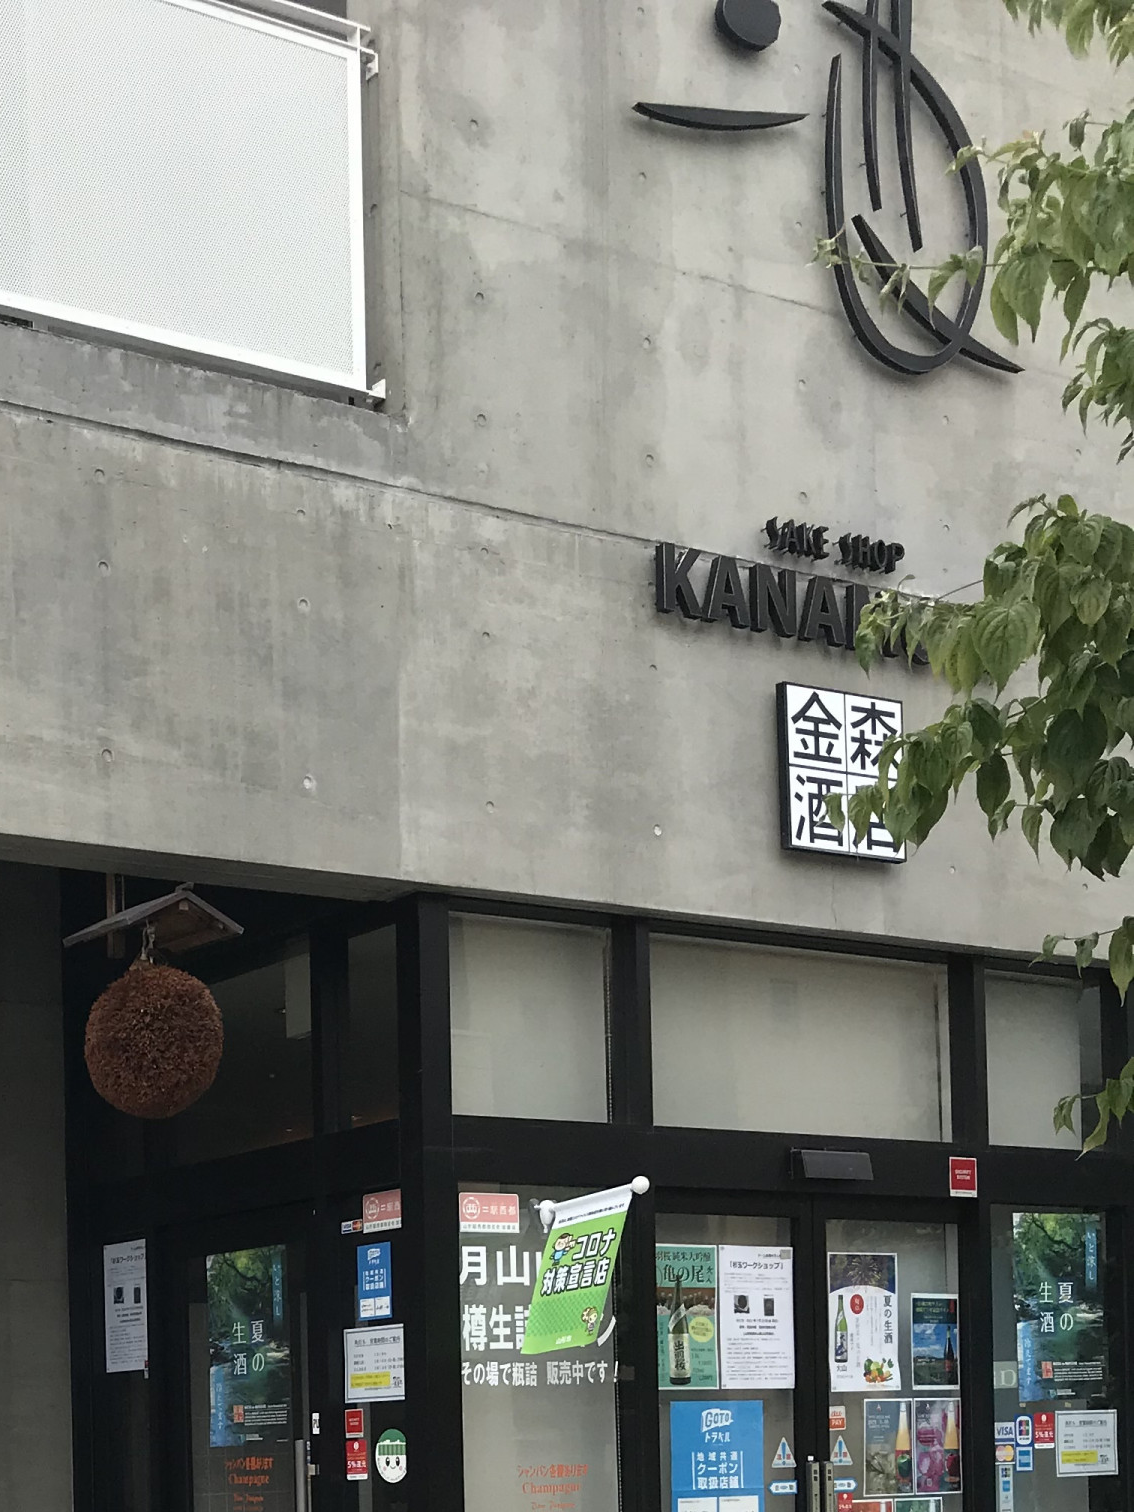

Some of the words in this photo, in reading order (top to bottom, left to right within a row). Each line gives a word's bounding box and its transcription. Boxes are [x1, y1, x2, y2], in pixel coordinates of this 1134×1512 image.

[762, 515, 830, 561] SAKE
[834, 531, 906, 575] SHOP
[790, 690, 900, 770] 金森
[571, 1228, 616, 1261] コロナ
[540, 1256, 612, 1297] 対策宣言店
[882, 1294, 894, 1345] 夏の生酒
[461, 1361, 538, 1387] その場で瓶詰
[704, 1431, 731, 1443] トラベル
[996, 1426, 1014, 1436] VISA
[696, 1451, 739, 1461] 地域共通
[697, 1463, 739, 1475] クーポン
[697, 1477, 739, 1490] 取扱店舗
